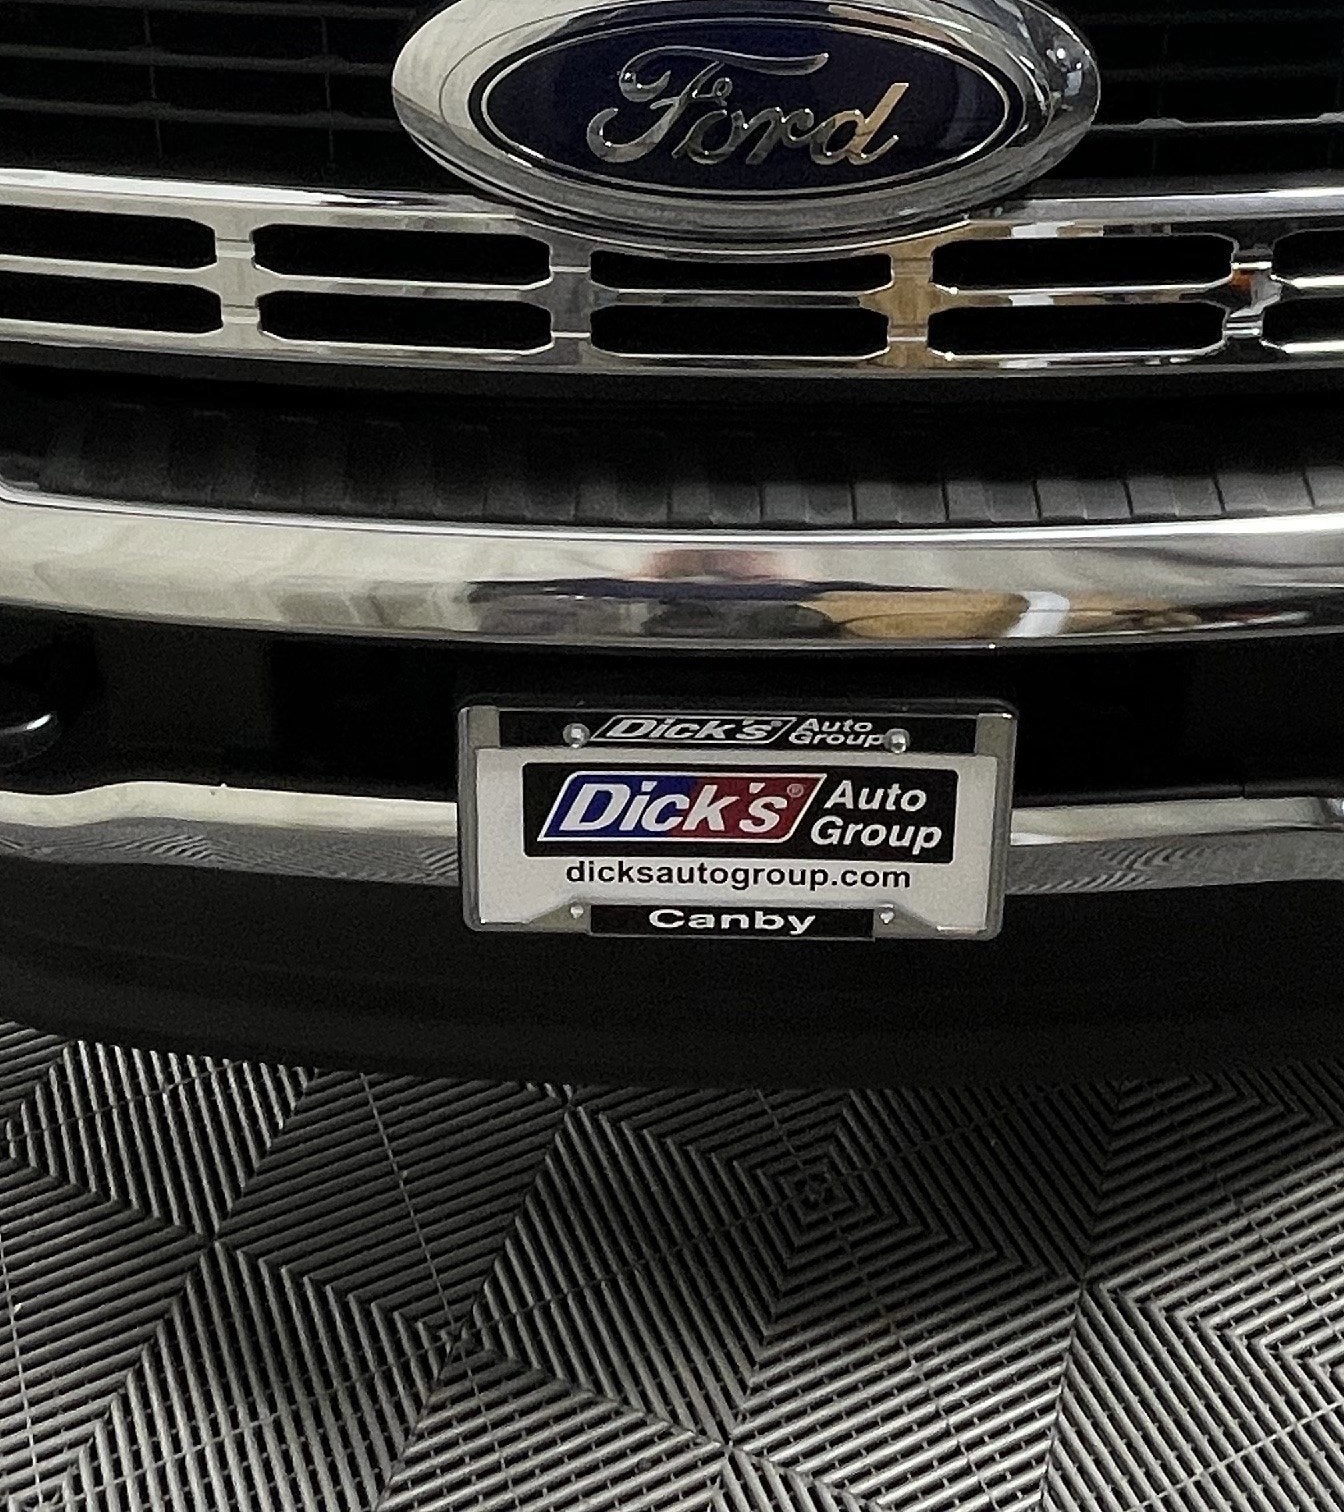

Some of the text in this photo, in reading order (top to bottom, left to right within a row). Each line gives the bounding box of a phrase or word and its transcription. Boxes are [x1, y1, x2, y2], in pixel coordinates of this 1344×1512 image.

[586, 45, 909, 166] Ford
[605, 716, 874, 742] Dick's Auto
[787, 731, 886, 748] Group
[558, 779, 928, 833] Dick's Auto
[809, 815, 943, 855] Group
[565, 861, 912, 891] dicksautogroup.com
[647, 907, 817, 936] Canby
